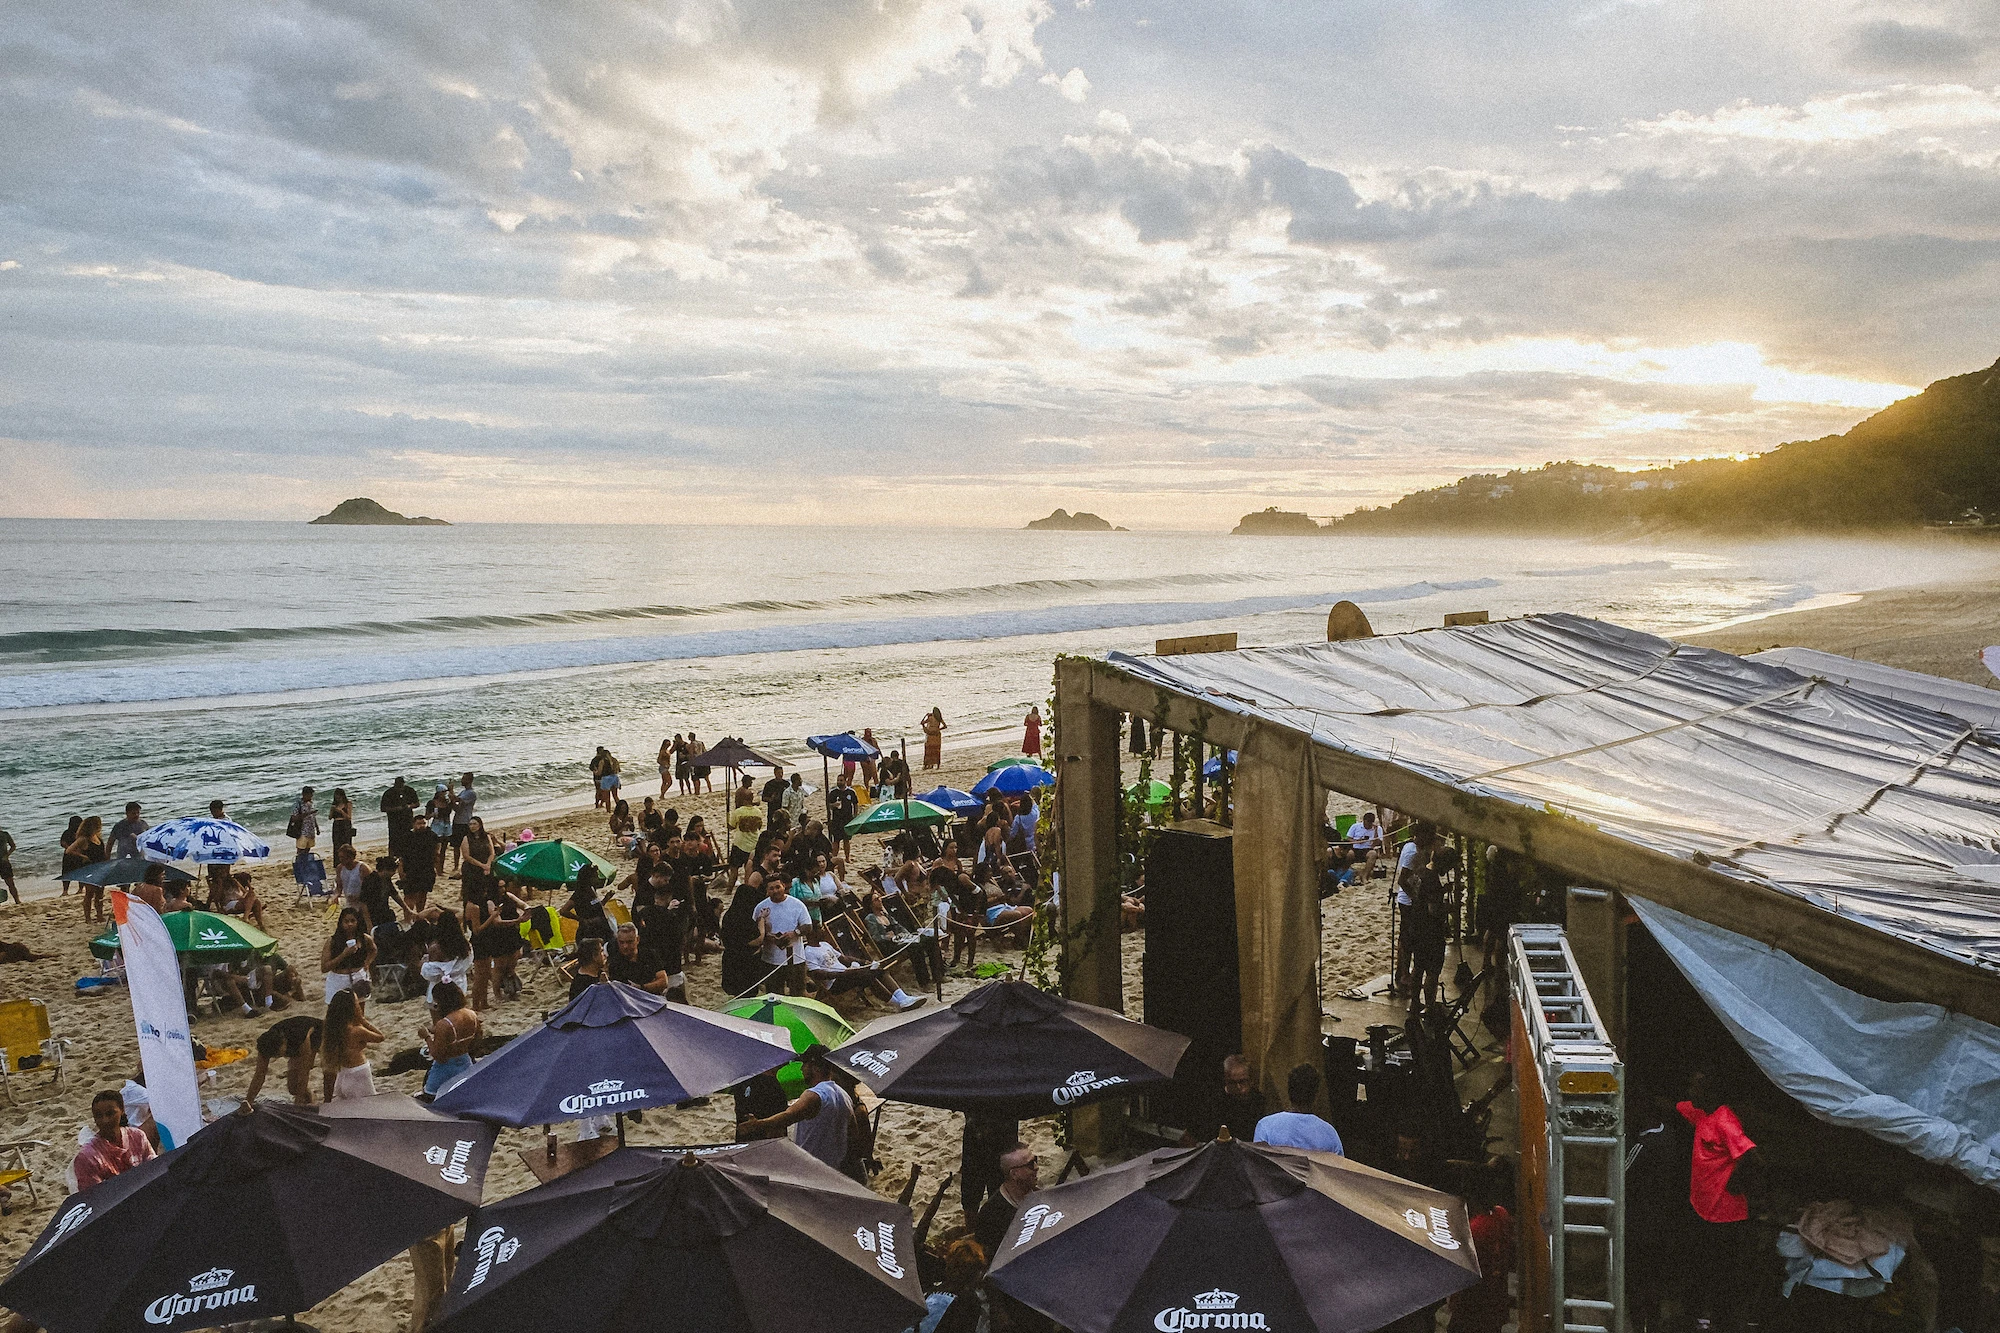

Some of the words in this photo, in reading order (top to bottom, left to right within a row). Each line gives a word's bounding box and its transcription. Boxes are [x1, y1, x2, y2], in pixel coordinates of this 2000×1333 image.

[850, 1051, 890, 1078] Corona
[559, 1088, 648, 1114] Corona
[1053, 1076, 1126, 1105] Corona
[440, 1140, 474, 1184] Corona
[1013, 1204, 1050, 1249] Corona
[1427, 1206, 1461, 1250] Corona
[464, 1226, 505, 1292] Corona
[875, 1221, 905, 1279] Corona
[144, 1285, 256, 1325] Corona
[1154, 1307, 1270, 1333] Corona
